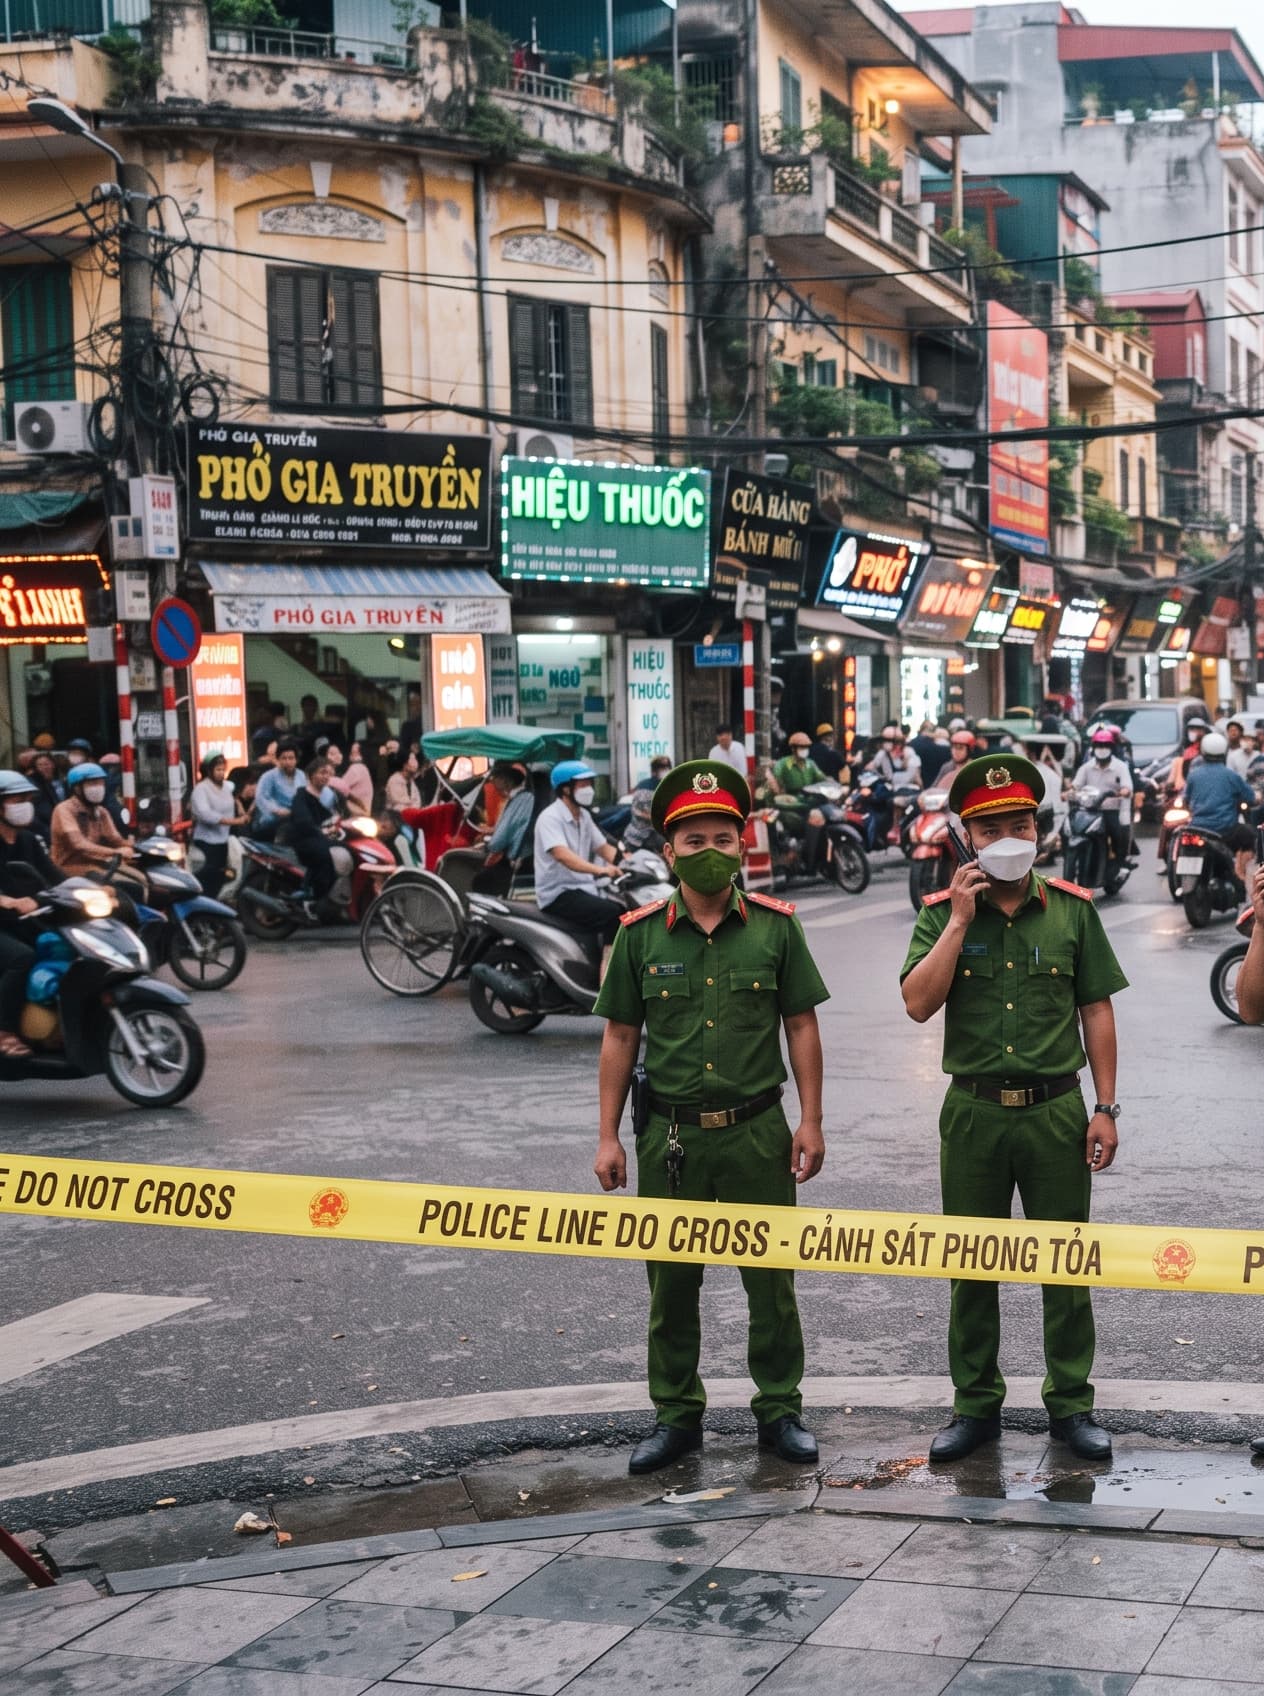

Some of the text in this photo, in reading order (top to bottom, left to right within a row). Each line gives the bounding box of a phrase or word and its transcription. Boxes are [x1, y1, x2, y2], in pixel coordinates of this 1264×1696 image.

[232, 431, 259, 443] GIA
[197, 440, 273, 502] PHỞ
[280, 459, 344, 505] GIA
[511, 466, 590, 530] HIỆU
[598, 470, 705, 528] THUỐC
[724, 519, 770, 555] BÁNH
[320, 610, 356, 626] GIA
[15, 1170, 58, 1206] DO
[65, 1174, 129, 1211] NOT
[134, 1178, 236, 1221] CROSS
[418, 1200, 530, 1241] POLICE
[537, 1207, 608, 1246] LINE
[615, 1212, 659, 1250] DO
[669, 1216, 771, 1257] CROSS
[799, 1214, 874, 1265] CẢNH
[882, 1222, 936, 1267] SÁT
[941, 1233, 1039, 1274] PHONG
[1049, 1227, 1102, 1277] TỎA
